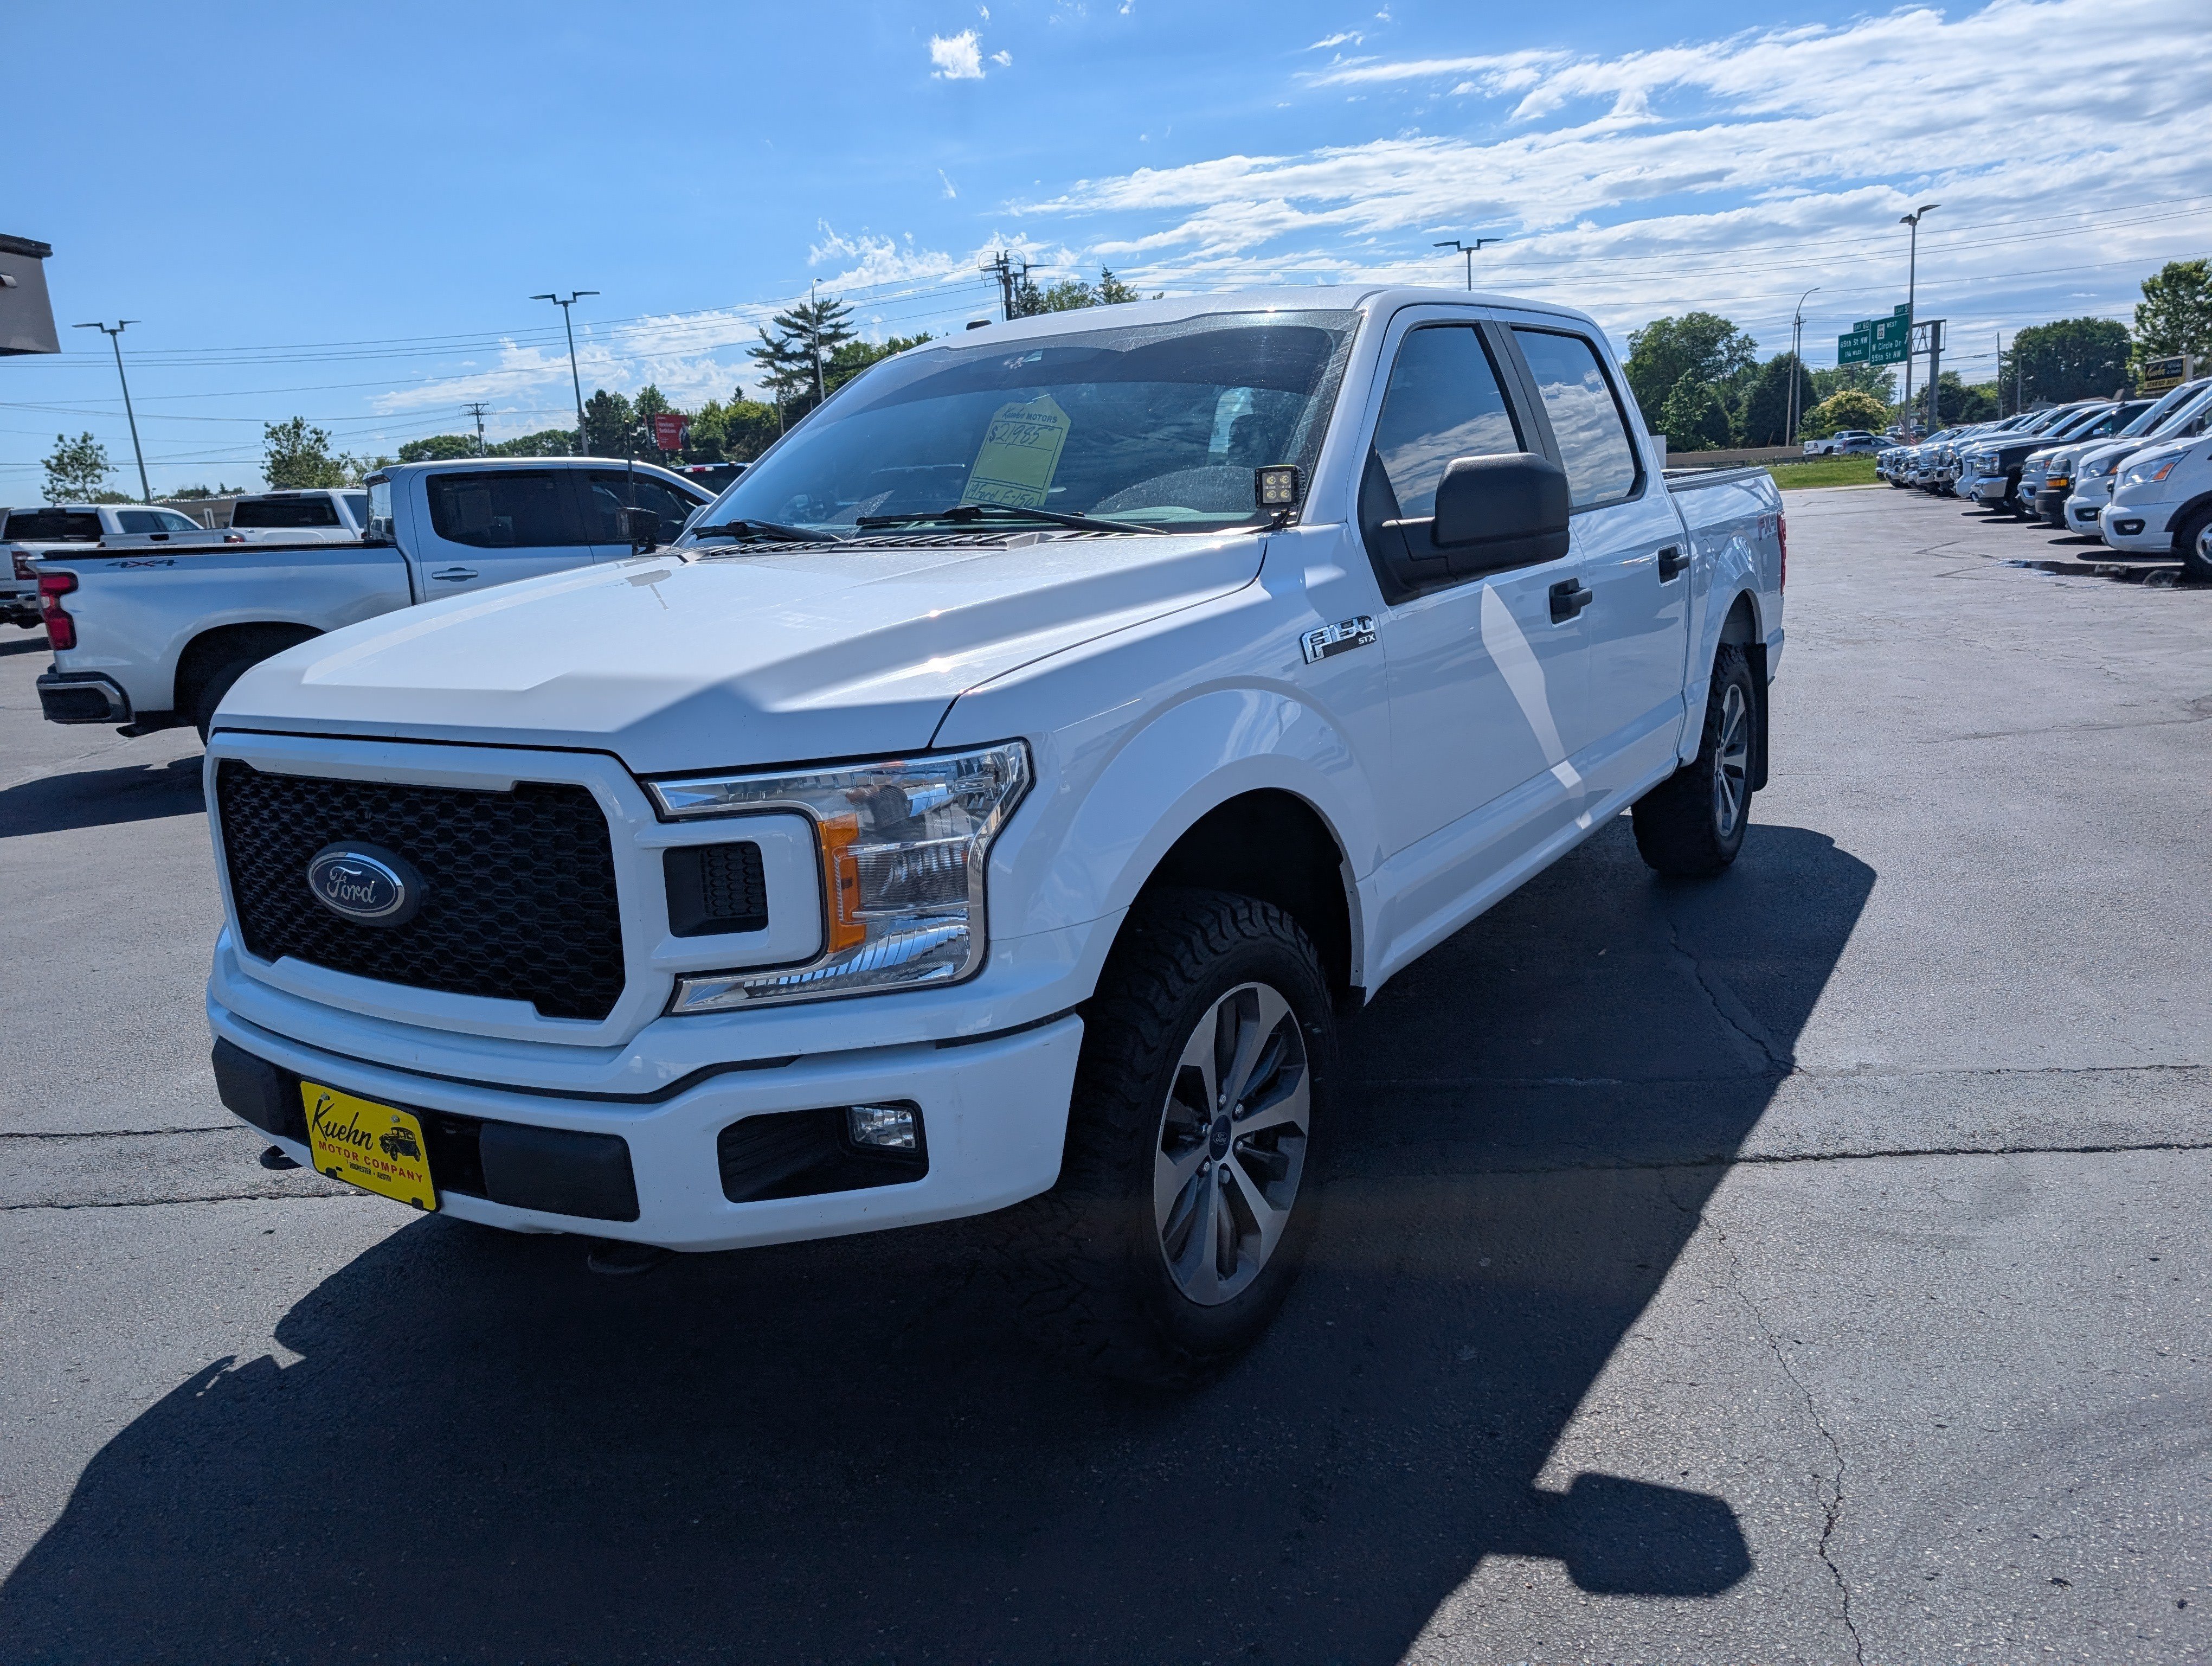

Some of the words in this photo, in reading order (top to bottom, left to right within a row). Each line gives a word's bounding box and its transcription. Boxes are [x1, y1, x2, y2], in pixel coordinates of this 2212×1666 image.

[1862, 321, 1869, 329] 60
[1887, 321, 1898, 329] WEST
[1840, 339, 1851, 348] 65th
[1853, 338, 1859, 346] St
[1860, 336, 1868, 344] NW
[1878, 341, 1893, 350] Circle
[1895, 339, 1901, 348] Dr
[1872, 354, 1883, 362] 55th
[1893, 350, 1901, 358] NW
[1026, 413, 1057, 424] MOTORS
[1358, 633, 1376, 644] STX
[326, 866, 376, 904] Ford
[311, 1098, 374, 1151] Kuehn
[318, 1140, 359, 1162] MOTOR
[364, 1156, 423, 1183] COMPANY
[349, 1161, 372, 1176] ROCHESTER
